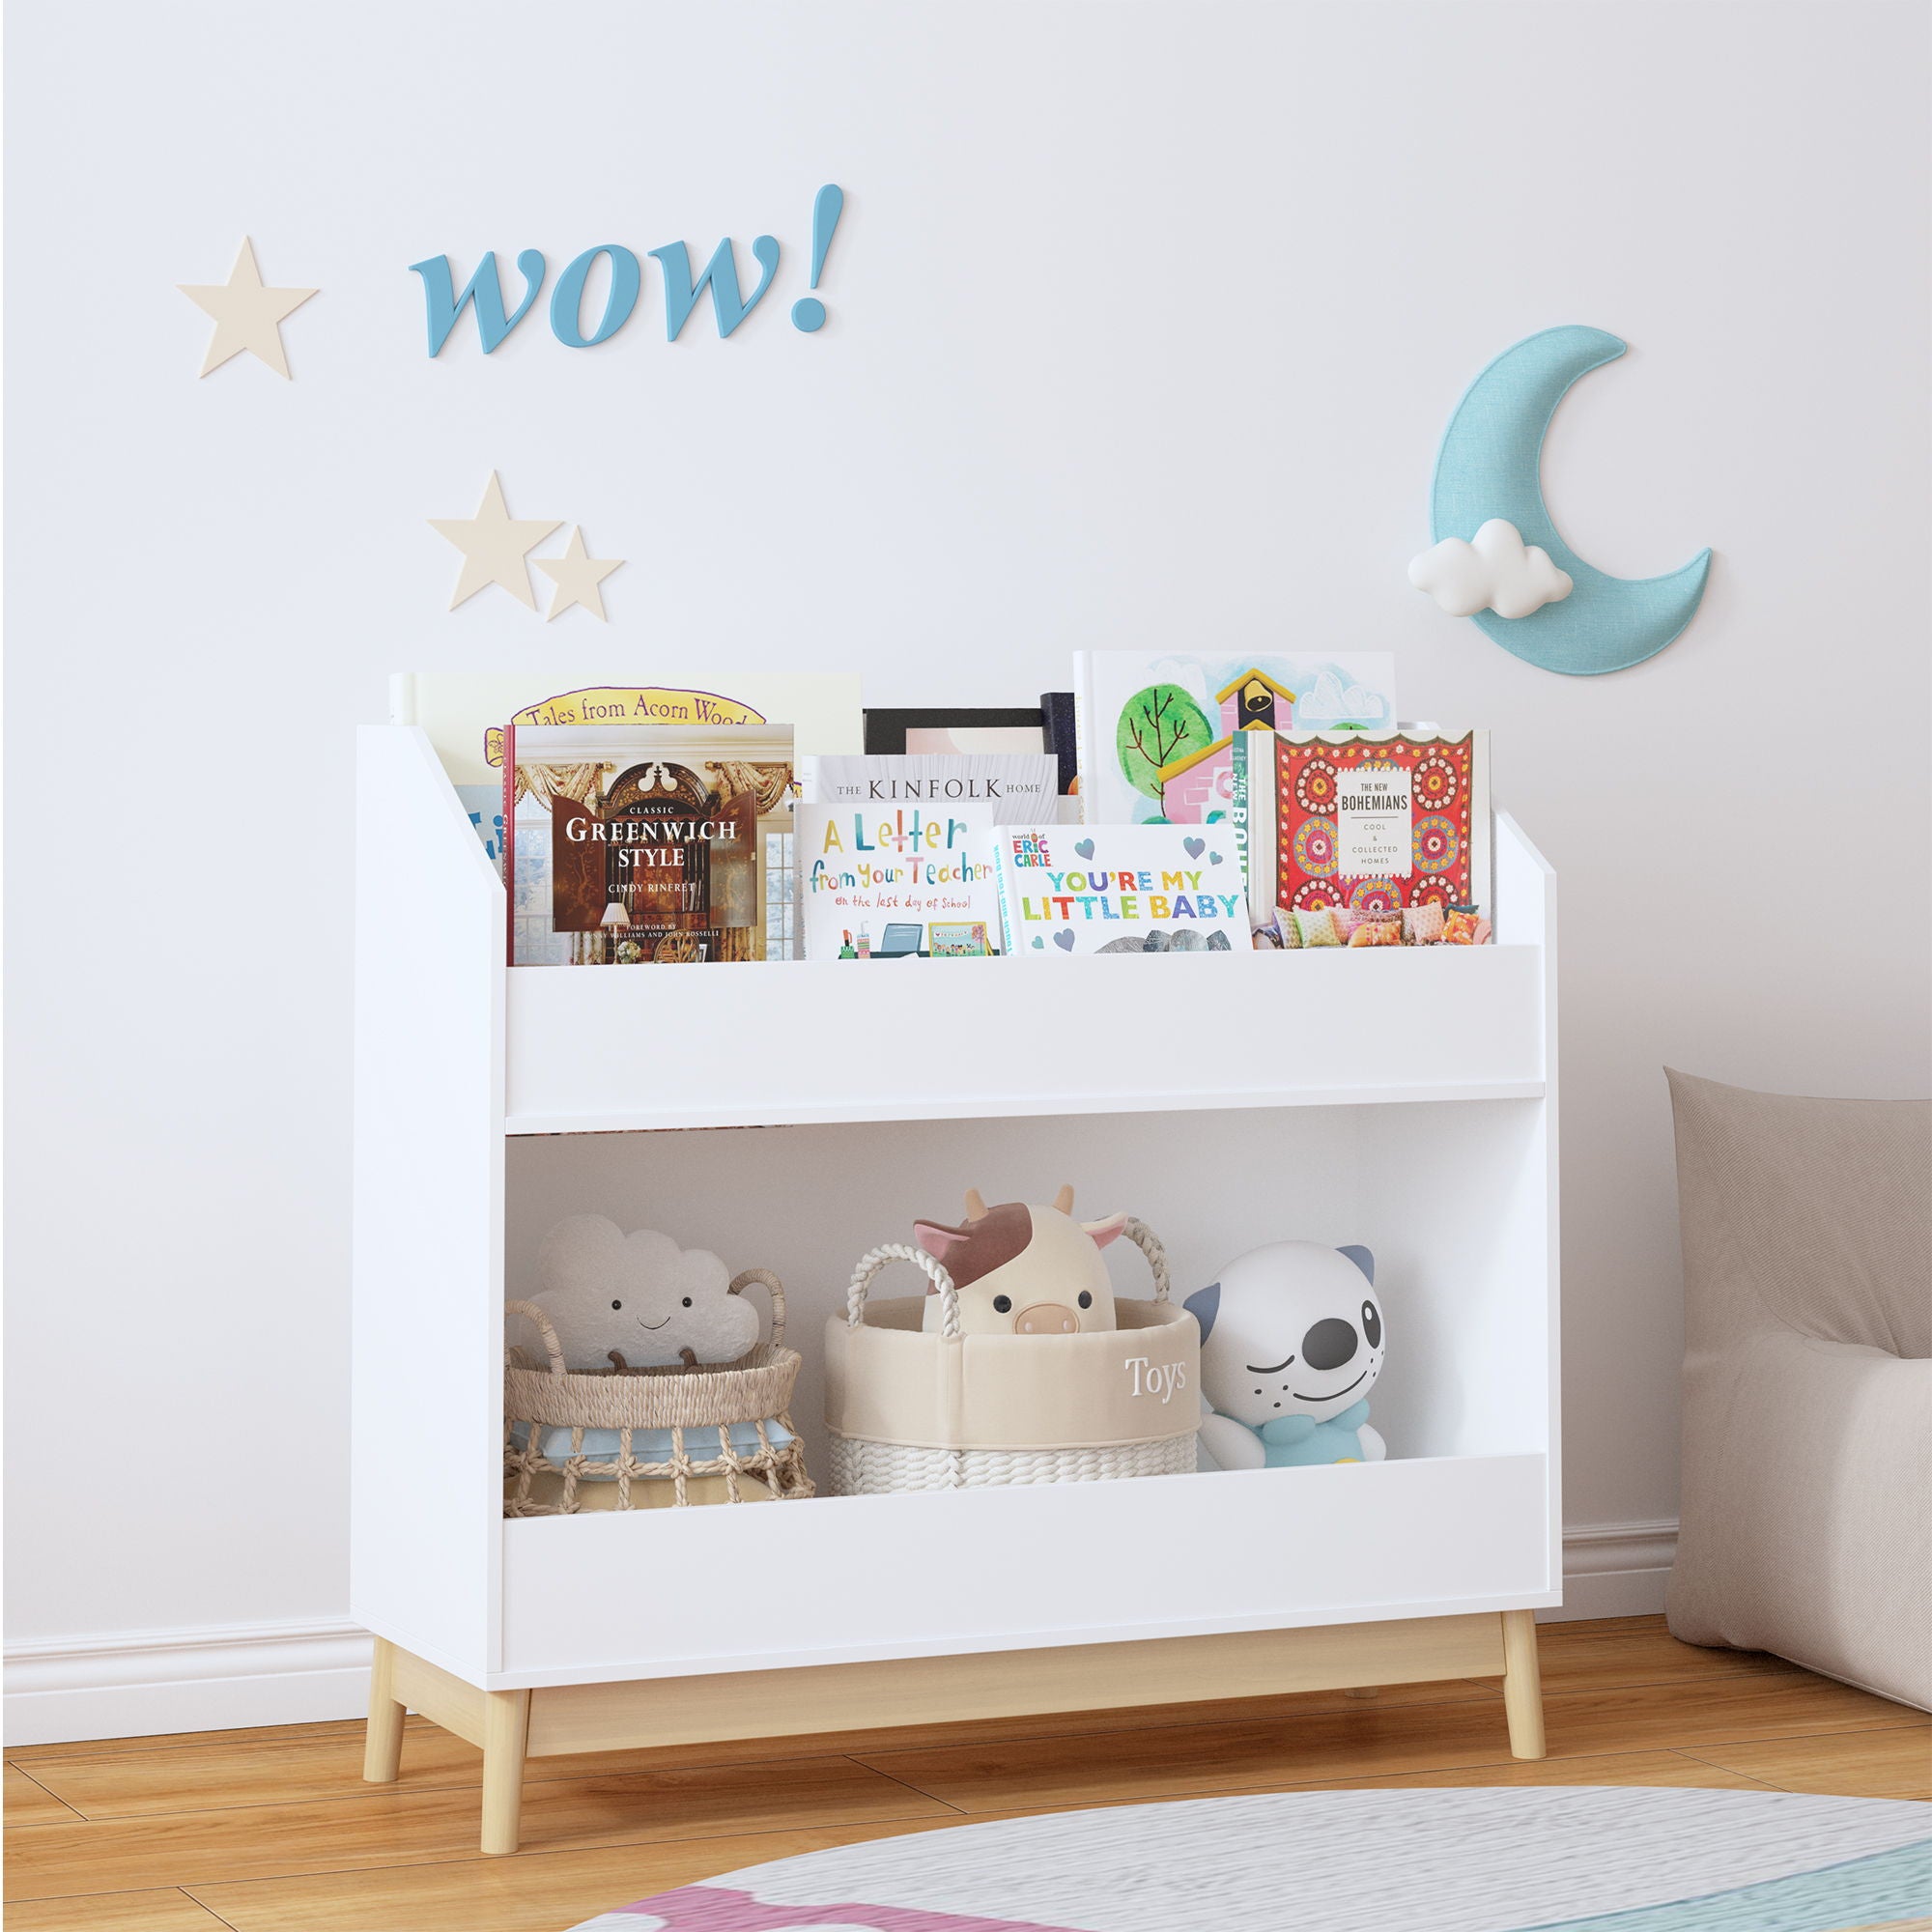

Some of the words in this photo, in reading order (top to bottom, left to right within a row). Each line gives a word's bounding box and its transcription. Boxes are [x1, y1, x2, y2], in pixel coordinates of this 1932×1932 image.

[409, 184, 843, 359] wow!
[582, 698, 626, 720] from
[634, 695, 689, 719] Acorn
[837, 785, 862, 795] THE
[868, 779, 1003, 799] KINFOLK
[1007, 783, 1041, 793] HOME
[1237, 778, 1246, 801] THE
[1360, 782, 1373, 792] THE
[1374, 782, 1388, 792] NEW
[1341, 795, 1407, 810] BOHEMIANS
[566, 817, 736, 842] GREENWICH
[823, 820, 844, 854] A
[854, 810, 967, 853] Letter
[618, 848, 685, 867] STYLE
[1014, 854, 1051, 867] CARLE
[1351, 845, 1398, 854] COLLECTED
[810, 859, 856, 894] from
[905, 852, 993, 885] Teacher
[1160, 870, 1204, 892] MY
[608, 884, 643, 894] CINDY
[648, 883, 695, 894] RINFRET
[835, 897, 849, 906] on
[852, 895, 871, 908] the
[876, 893, 898, 908] last
[904, 895, 922, 912] day
[926, 896, 939, 909] of
[1021, 895, 1140, 921] LITTLE
[1149, 895, 1239, 919] BABY
[1124, 1356, 1186, 1405] Toys
